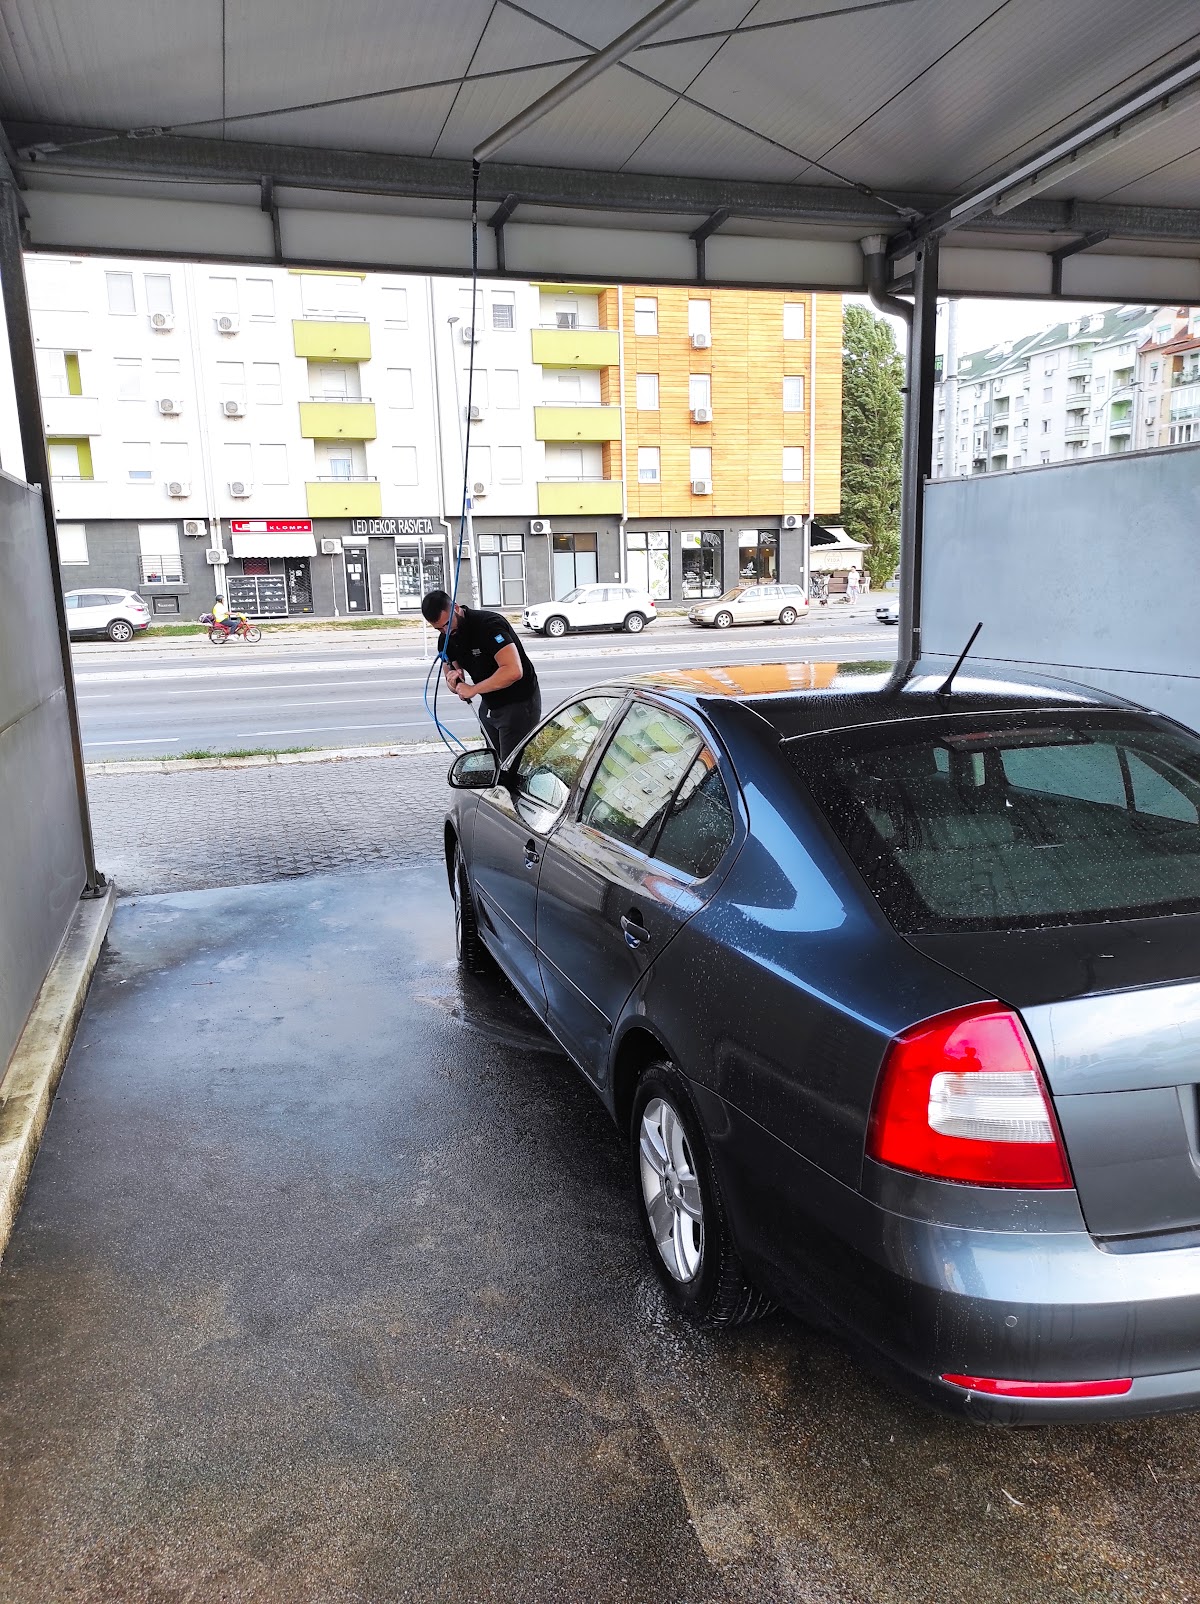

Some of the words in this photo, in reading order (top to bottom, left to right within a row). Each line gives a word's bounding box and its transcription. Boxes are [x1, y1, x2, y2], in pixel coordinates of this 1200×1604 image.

[352, 519, 368, 534] LED
[369, 519, 397, 534] DEKOR
[398, 518, 434, 534] RASVETA
